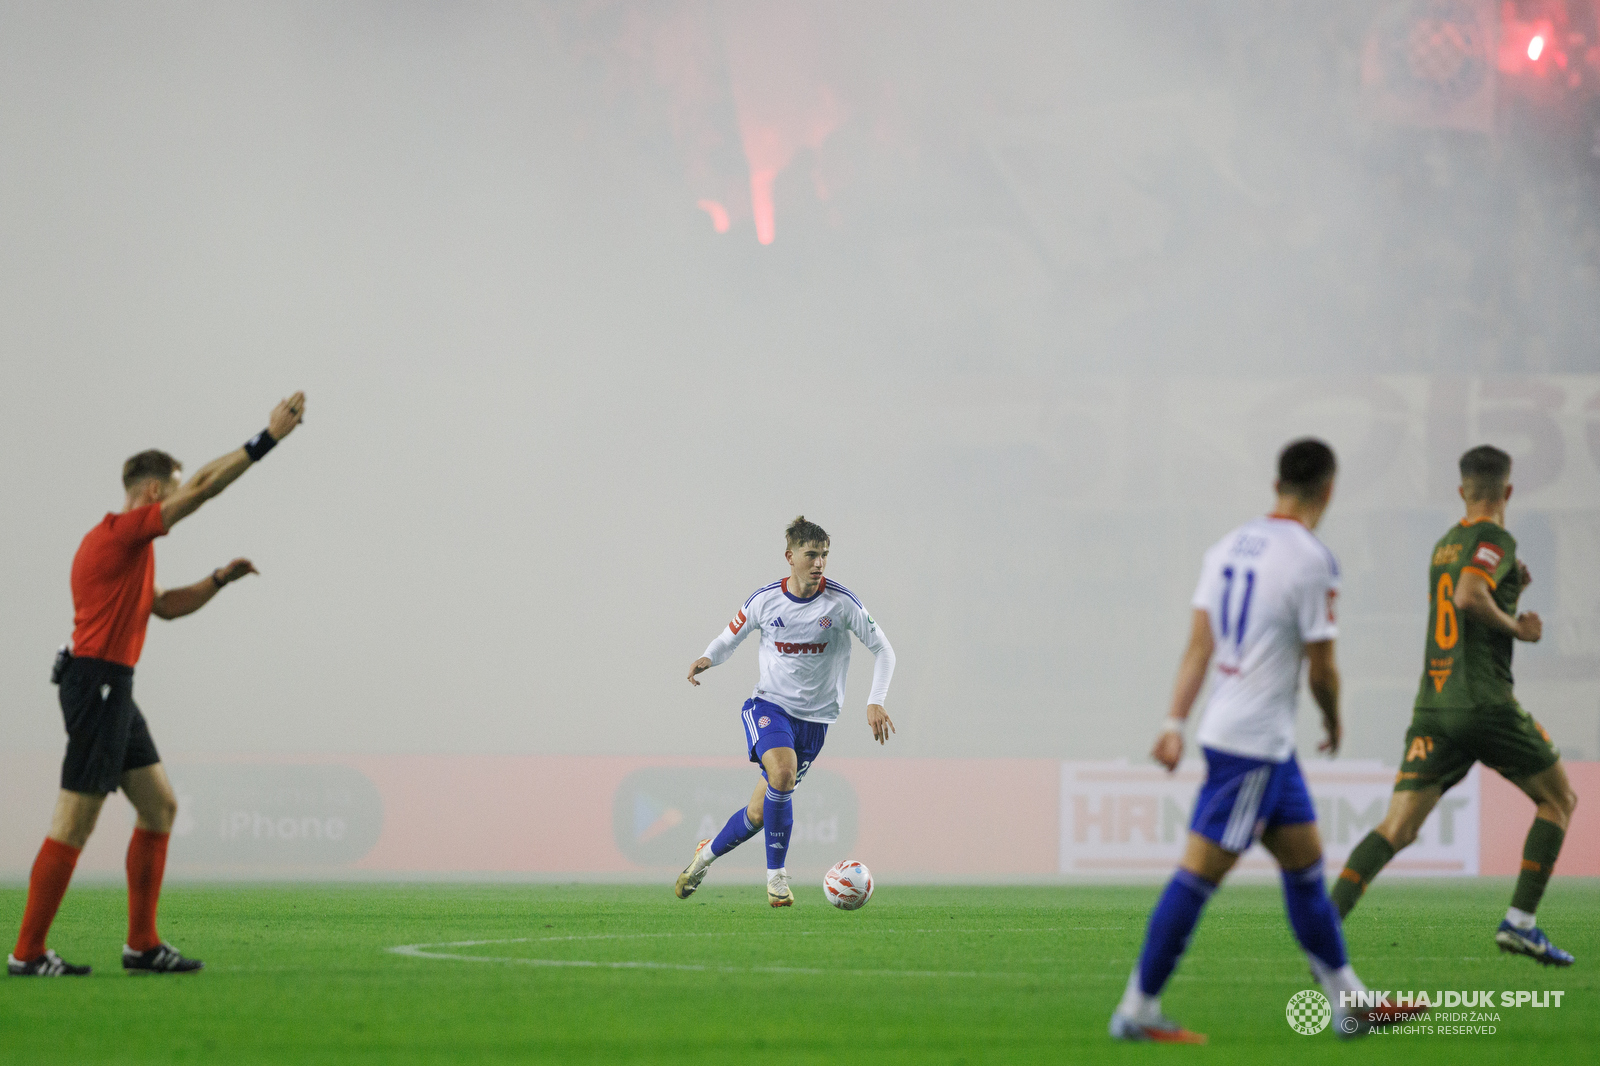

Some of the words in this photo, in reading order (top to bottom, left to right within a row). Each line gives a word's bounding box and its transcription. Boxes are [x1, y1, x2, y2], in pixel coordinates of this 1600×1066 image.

[1221, 566, 1255, 645] 11
[1435, 572, 1459, 650] 6
[774, 641, 829, 655] TOMMY
[219, 809, 347, 841] iPhone
[696, 813, 838, 843] Aoid
